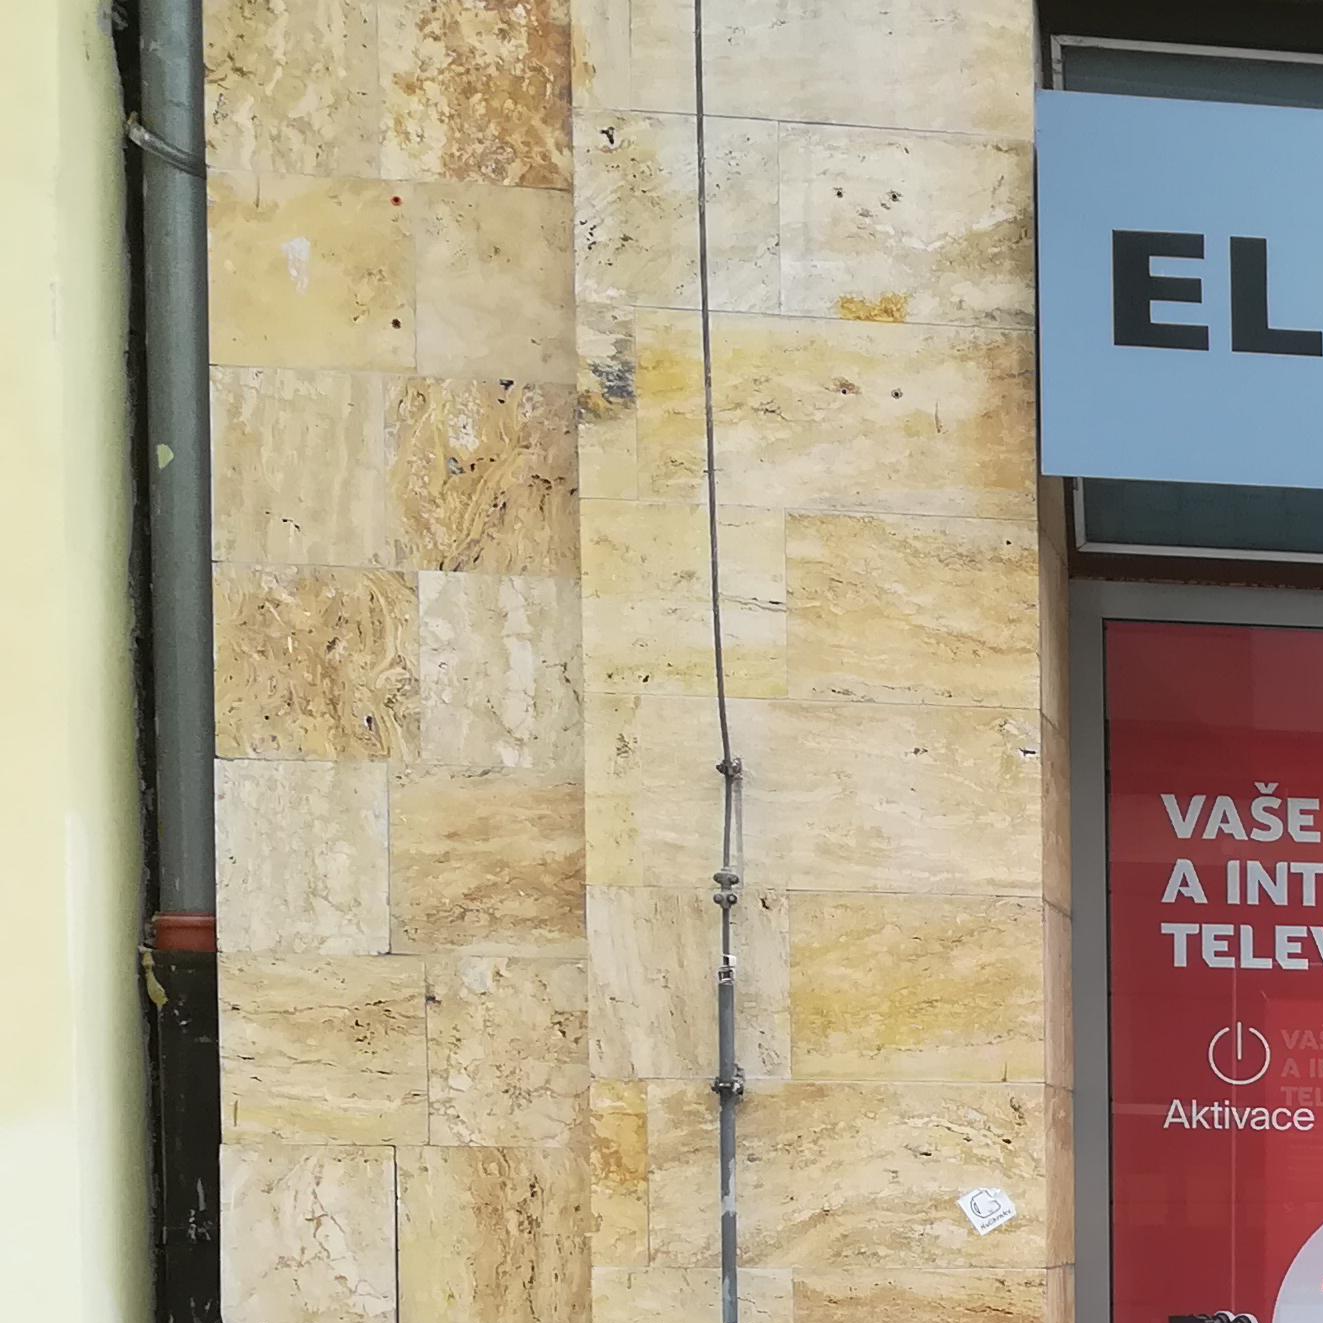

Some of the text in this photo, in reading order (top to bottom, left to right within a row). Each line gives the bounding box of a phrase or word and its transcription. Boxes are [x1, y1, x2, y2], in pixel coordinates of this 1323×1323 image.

[1160, 781, 1322, 845] VAŠE
[1161, 858, 1209, 905] A
[1163, 1099, 1316, 1131] Aktivace
